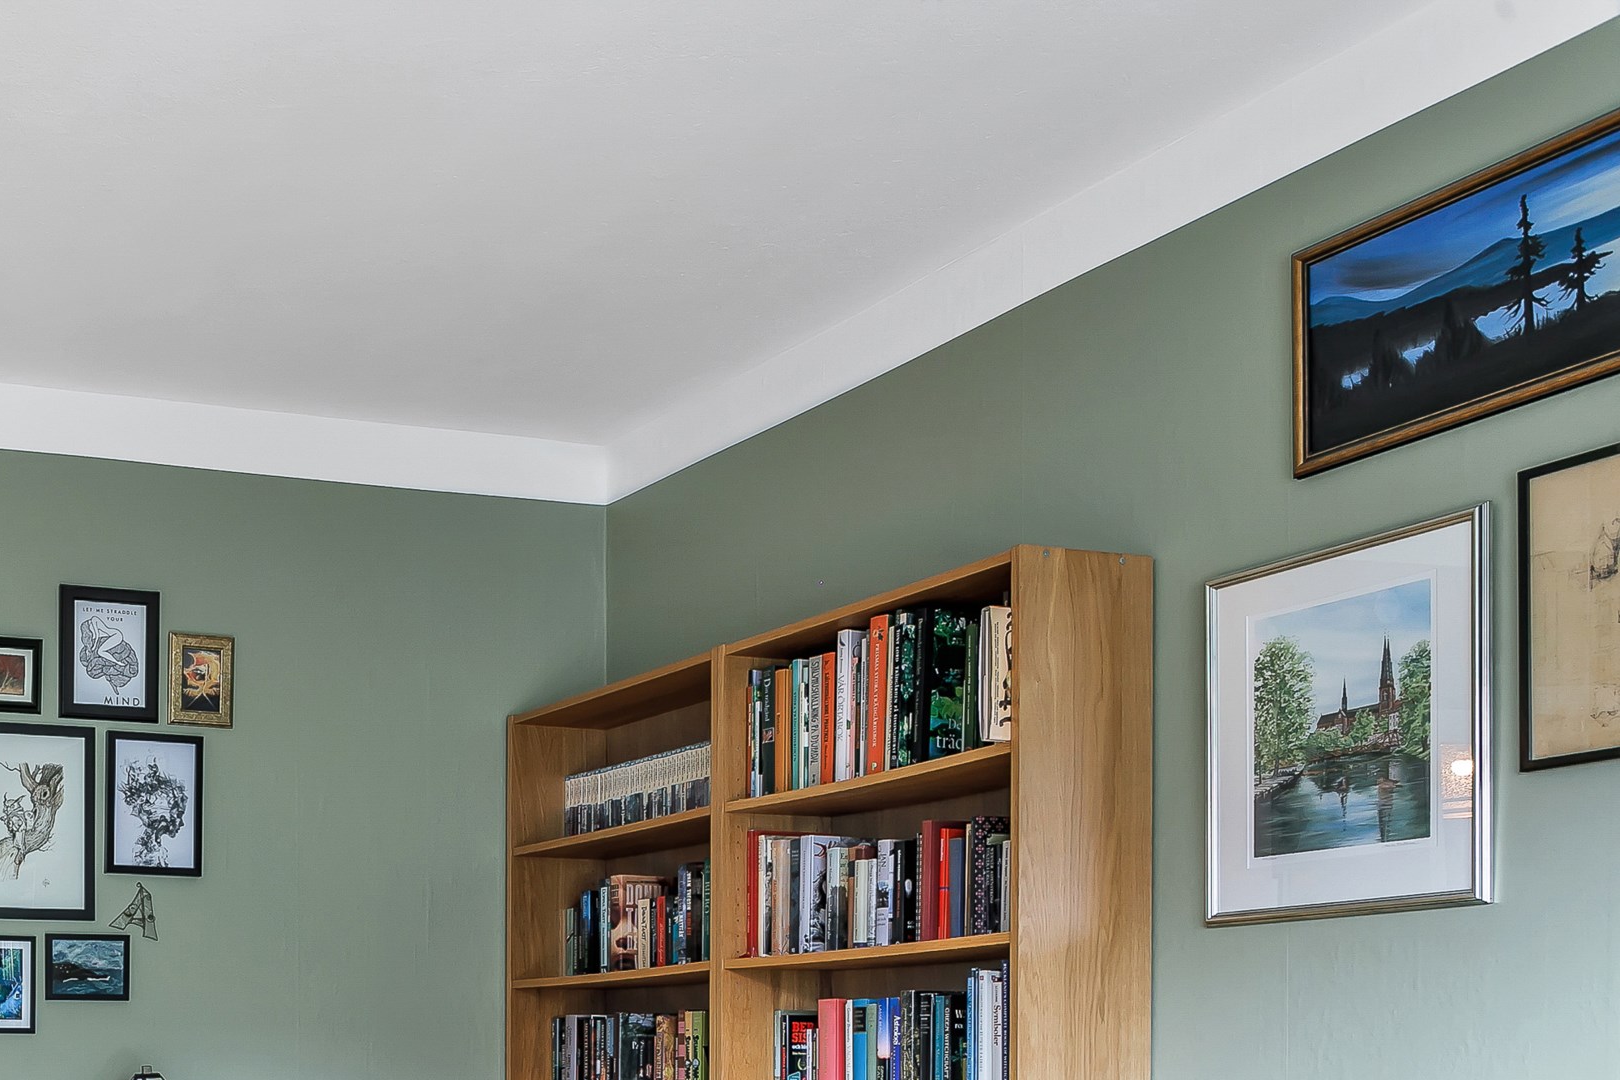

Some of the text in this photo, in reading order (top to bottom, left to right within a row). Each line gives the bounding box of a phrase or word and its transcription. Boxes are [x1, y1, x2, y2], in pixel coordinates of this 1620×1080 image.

[106, 608, 138, 616] STRADDLE
[103, 696, 140, 707] MIND
[837, 674, 846, 743] VÅR ÖRTABOK
[892, 1015, 901, 1046] Astrologi
[992, 1004, 1001, 1046] Symboler
